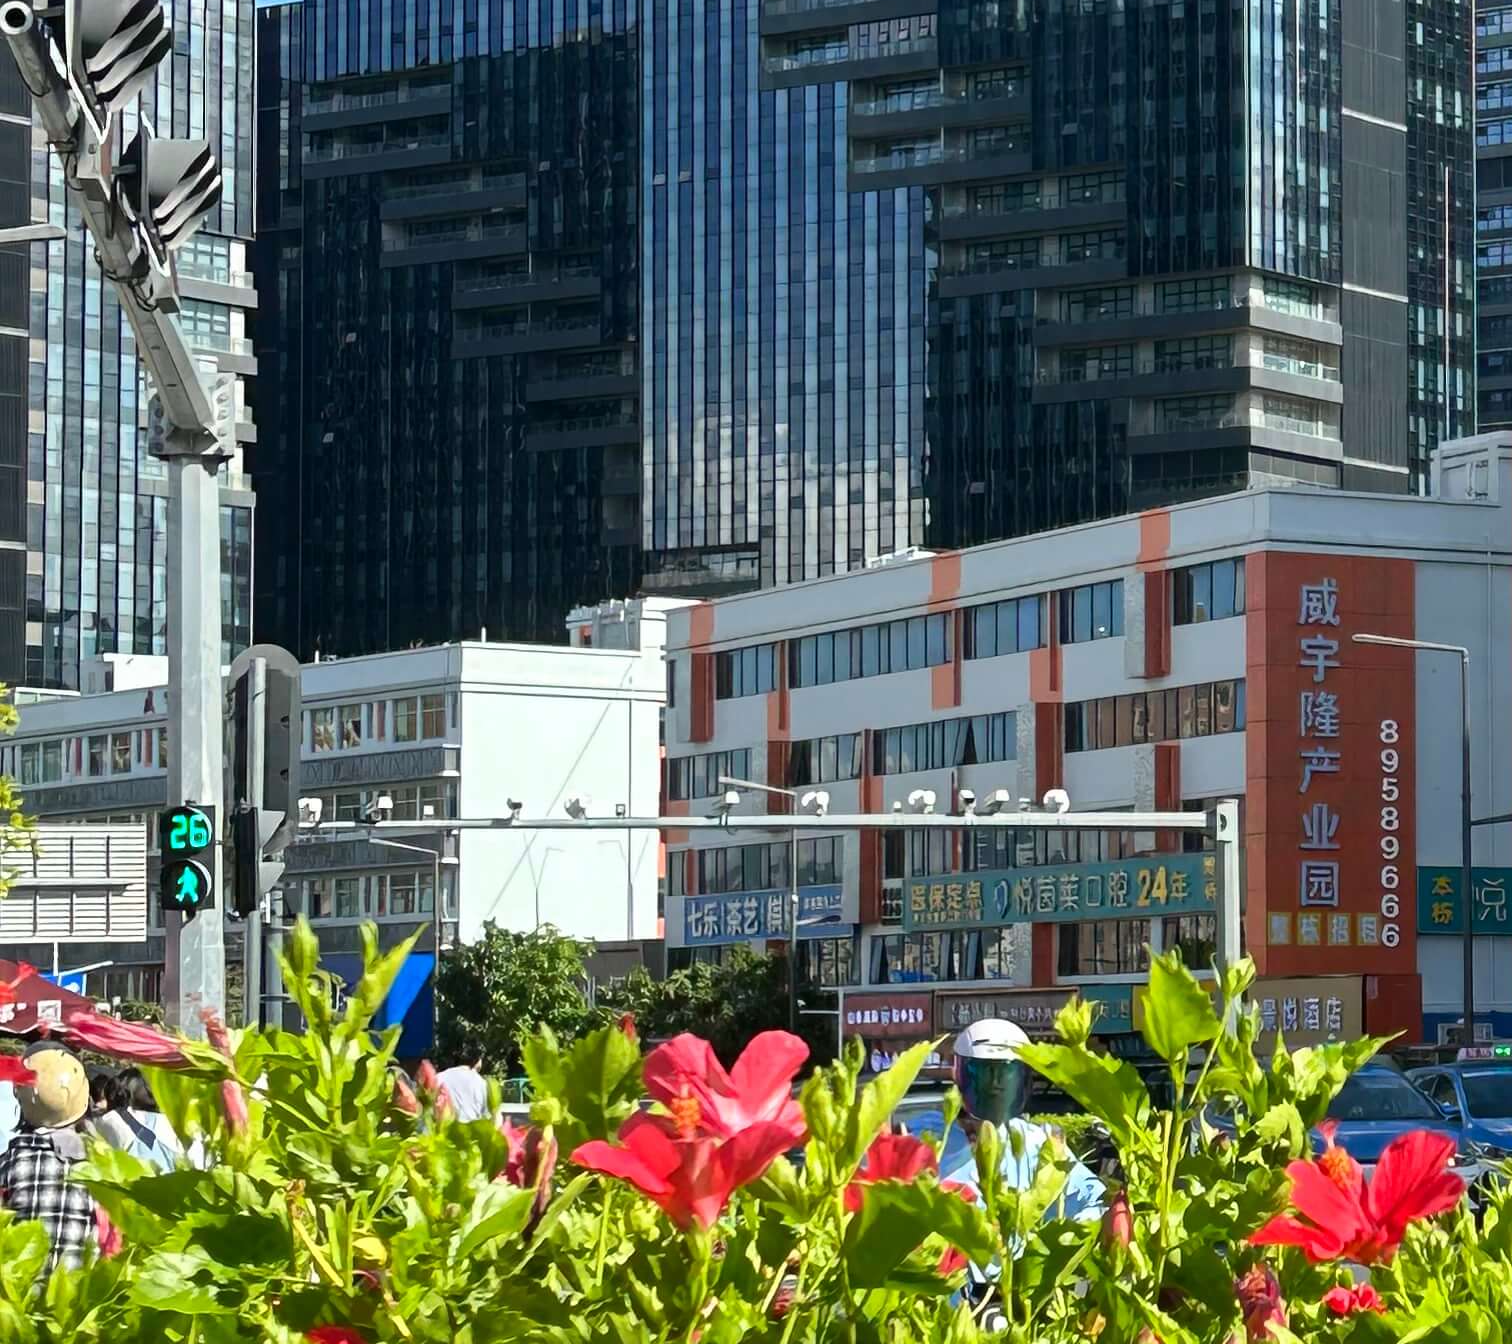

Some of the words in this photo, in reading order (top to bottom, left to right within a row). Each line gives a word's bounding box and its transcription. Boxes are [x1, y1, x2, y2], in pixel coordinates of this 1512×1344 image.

[170, 814, 209, 849] 26
[1297, 577, 1341, 908] 威宇隆产业园
[1379, 719, 1401, 948] 89589666
